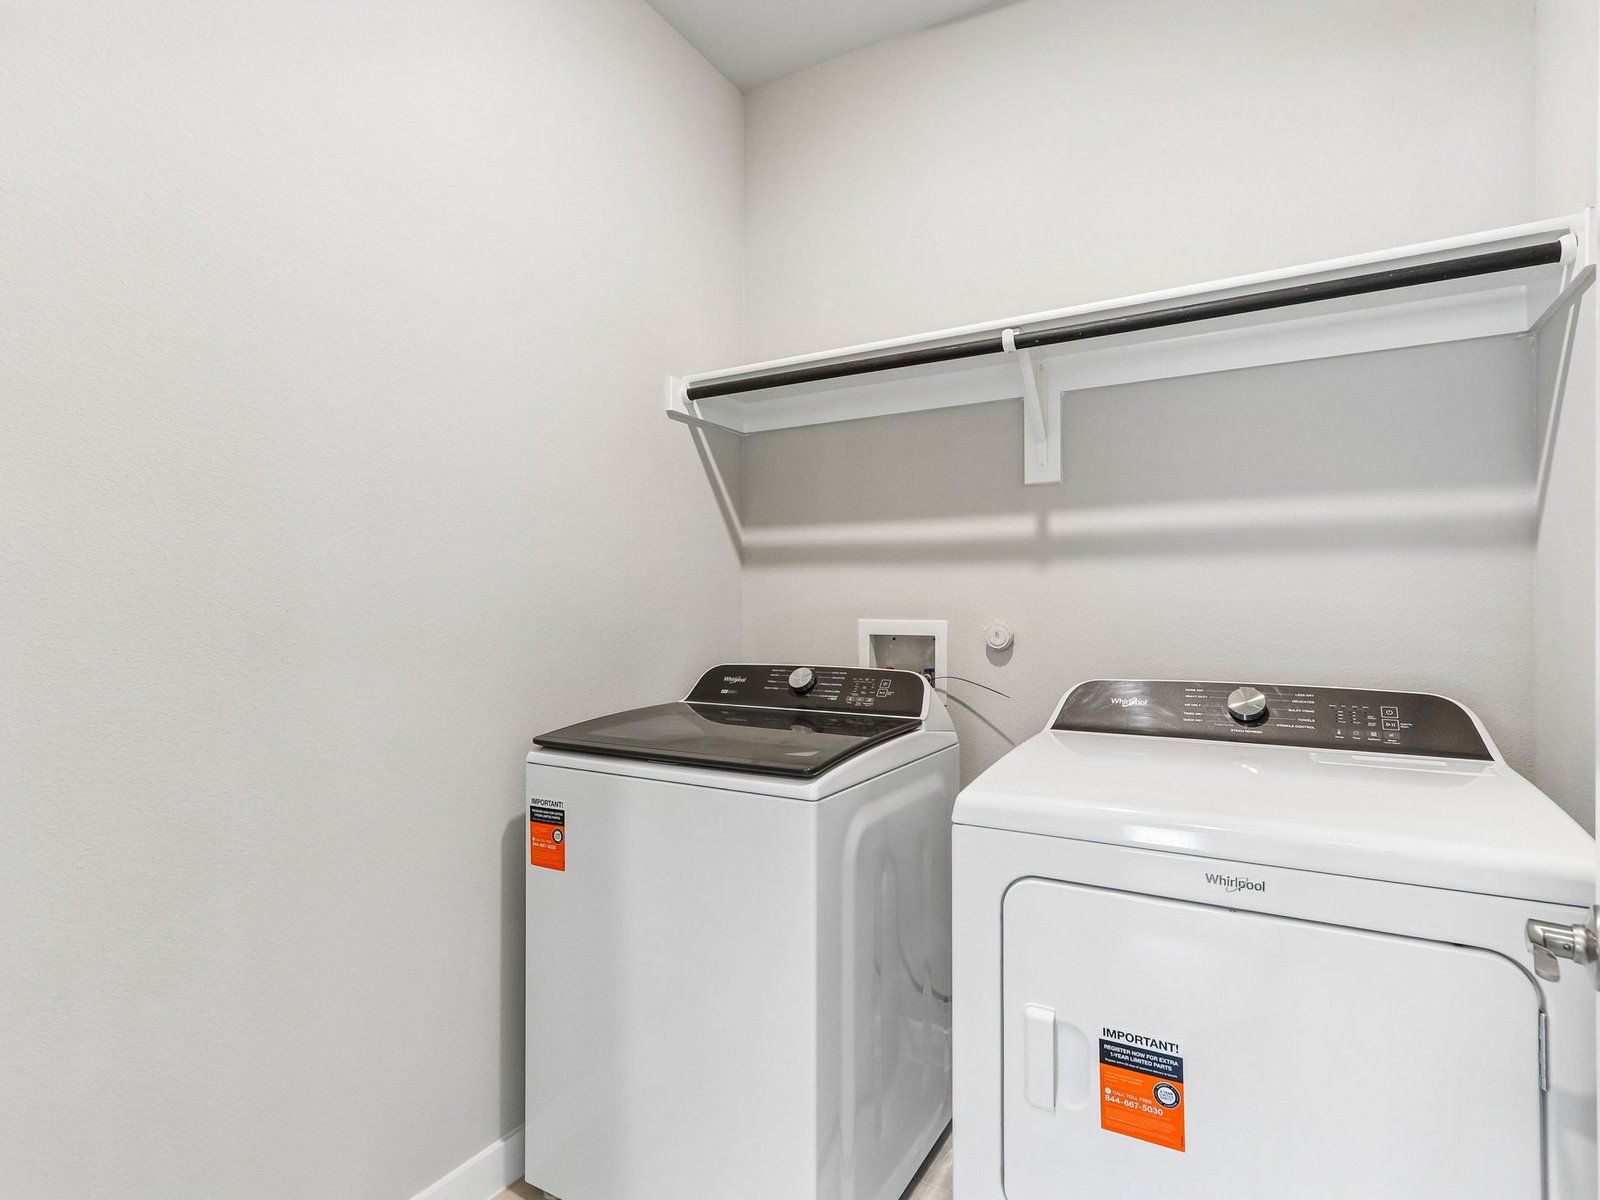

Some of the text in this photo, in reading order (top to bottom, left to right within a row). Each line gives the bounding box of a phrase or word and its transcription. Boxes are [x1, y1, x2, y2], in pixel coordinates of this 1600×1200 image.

[1111, 697, 1147, 707] Whirlpool
[531, 798, 563, 808] IMPORTANT!
[1205, 872, 1265, 892] Whirlpool
[1102, 1027, 1179, 1054] IMPORTANT!
[1103, 1044, 1131, 1055] REGISTER
[1132, 1050, 1145, 1058] NOW
[1159, 1057, 1179, 1067] EXTRA
[1110, 1051, 1129, 1061] 1-YEAR
[1130, 1056, 1153, 1066] LIMITED
[1153, 1062, 1172, 1072] PARTS
[1105, 1094, 1164, 1116] 844-667-5030
[1126, 1093, 1138, 1101] TOLL
